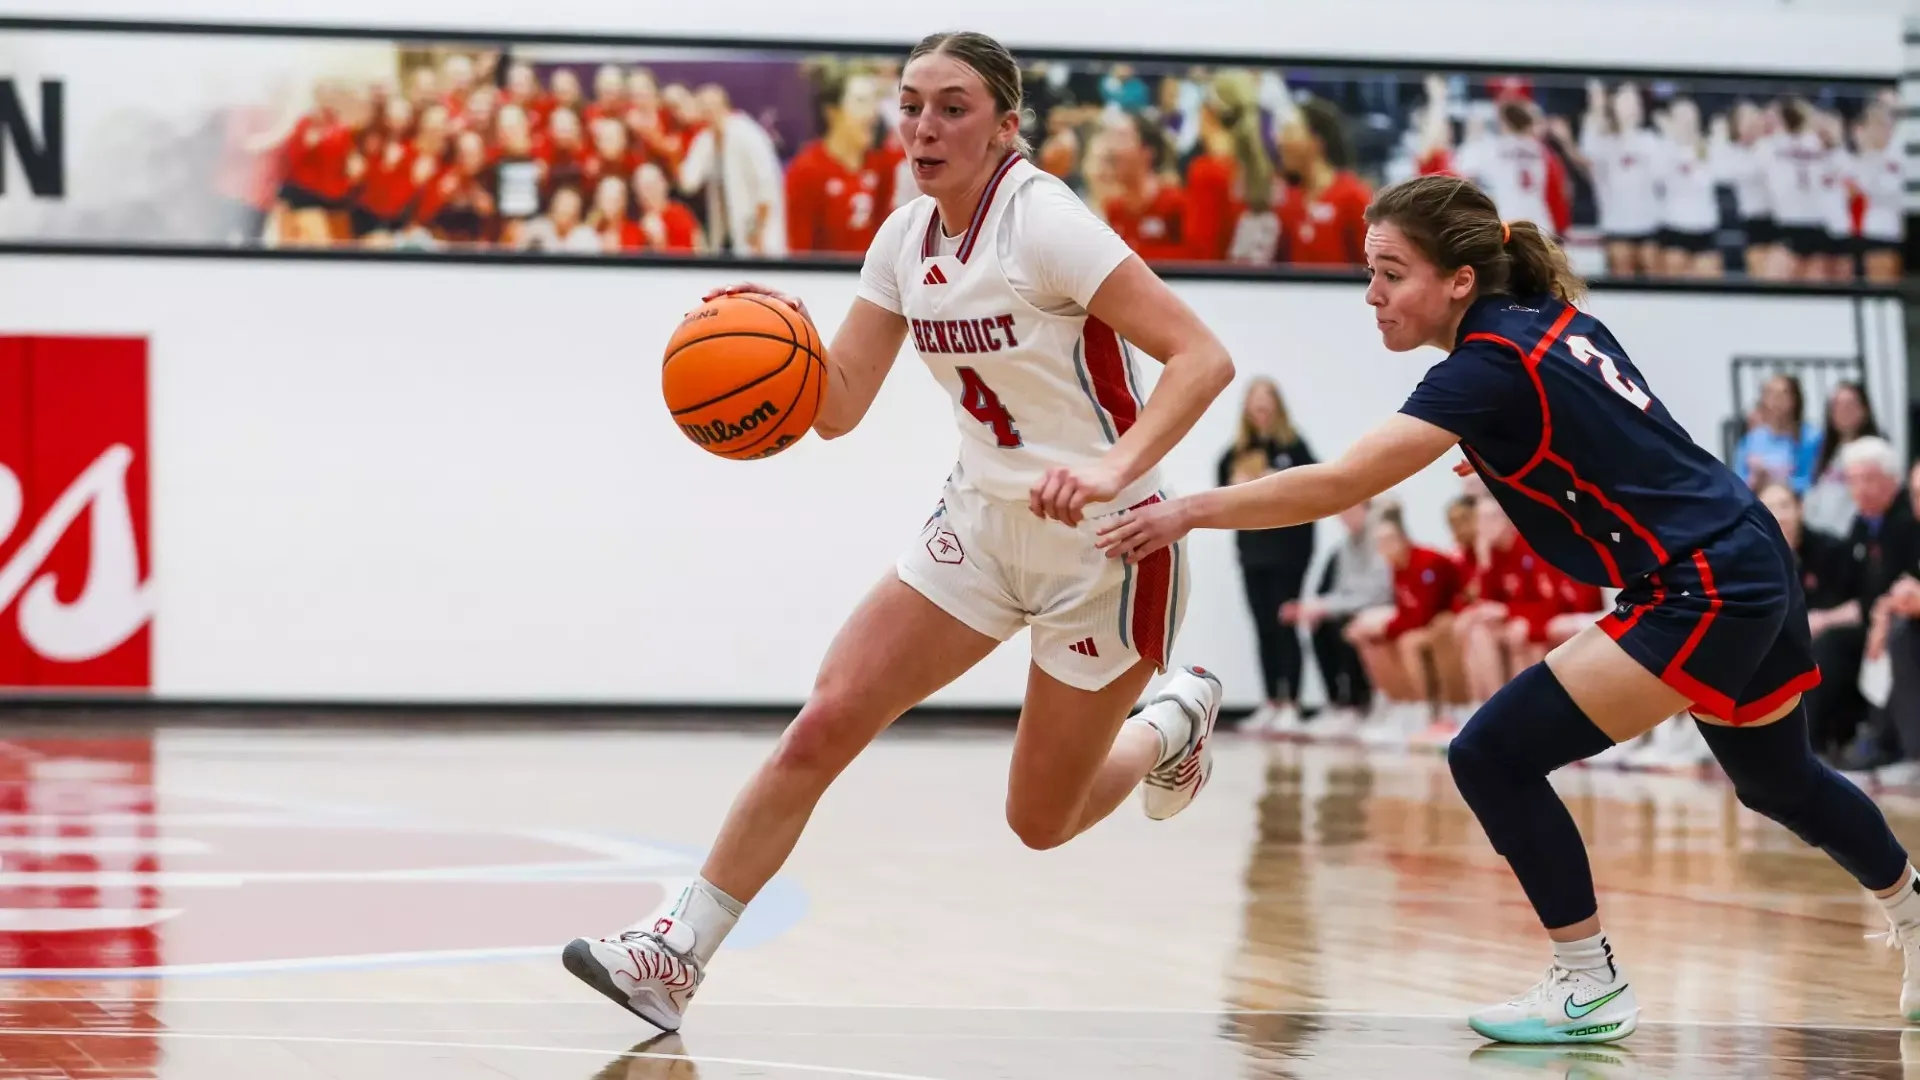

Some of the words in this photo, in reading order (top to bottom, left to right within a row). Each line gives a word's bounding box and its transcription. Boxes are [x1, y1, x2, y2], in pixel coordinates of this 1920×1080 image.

[912, 313, 1019, 354] BENEDICT
[1565, 334, 1652, 415] 2
[681, 400, 779, 447] Wilson
[955, 365, 1024, 449] 4
